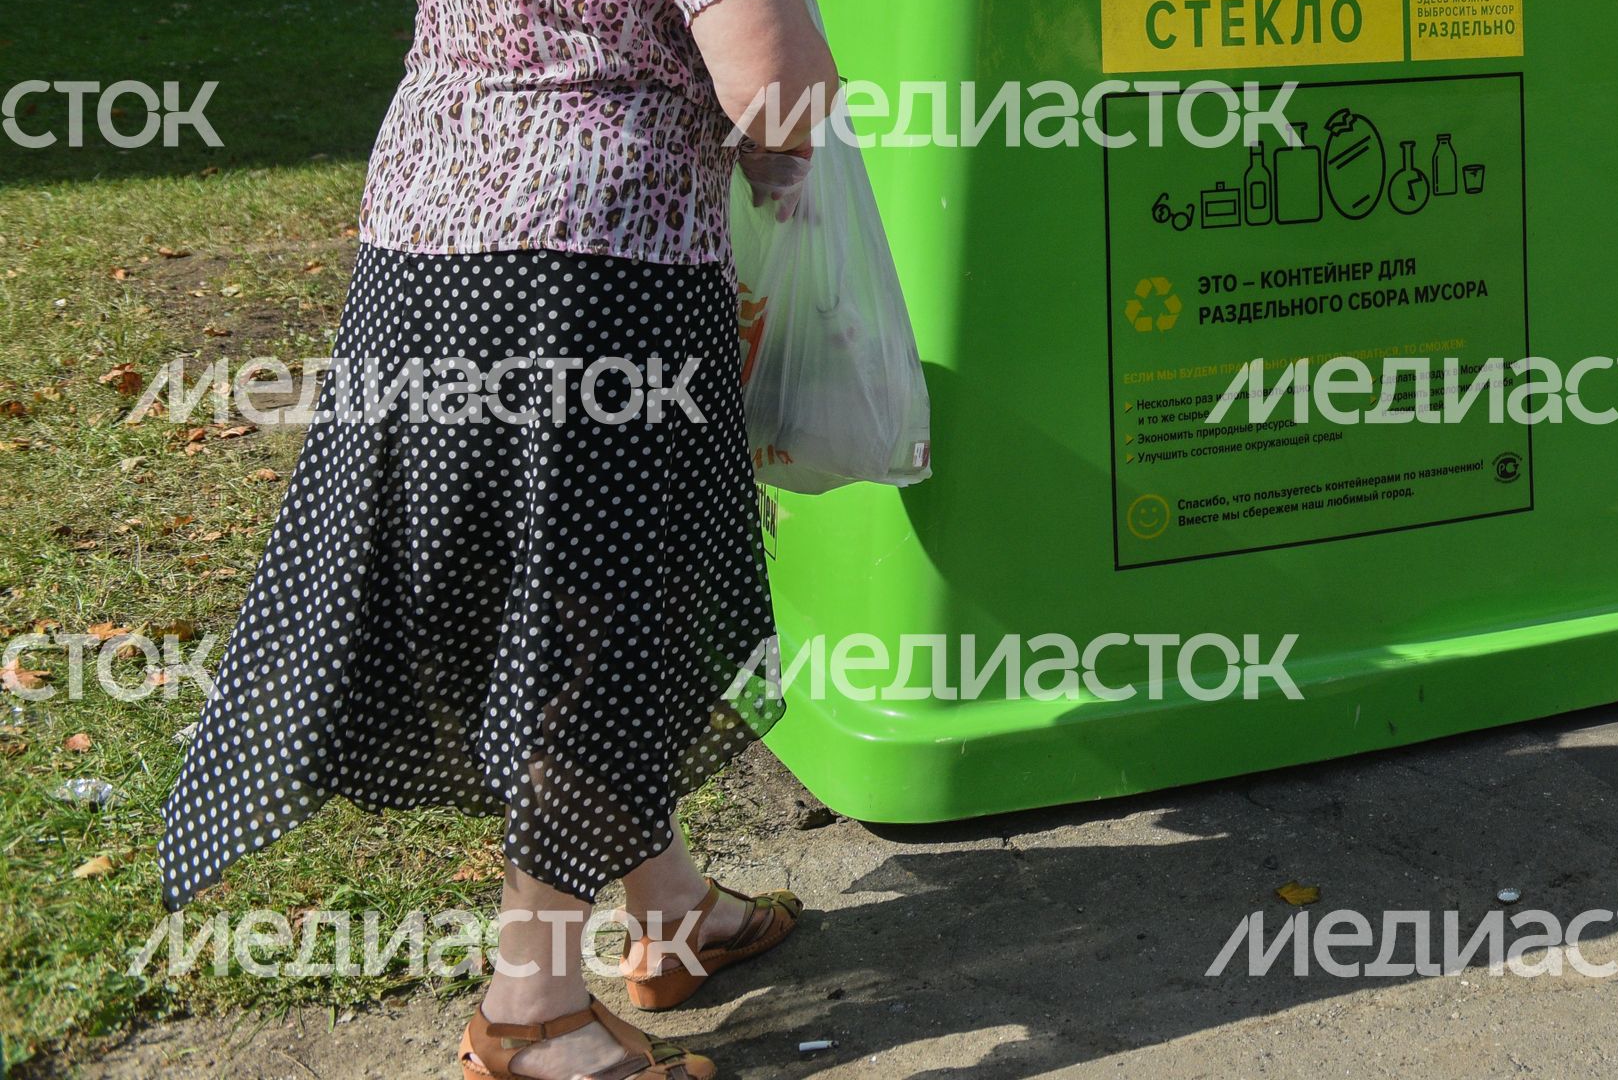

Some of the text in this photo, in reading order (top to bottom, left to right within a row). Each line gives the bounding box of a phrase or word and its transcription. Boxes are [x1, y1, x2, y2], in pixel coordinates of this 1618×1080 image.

[1417, 5, 1514, 18] ВЫБРОСИТЬ МУСОР
[1418, 19, 1515, 40] РАЗДЕЛЬНО
[1197, 273, 1238, 295] ЭТО
[1260, 262, 1373, 290] КОНТЕЙНЕР
[1378, 257, 1416, 281] ДЛЯ
[1199, 279, 1488, 325] РАЗДЕЛЬНОГО СБОРА МУСОРА
[1136, 396, 1193, 411] Несколько
[1195, 394, 1213, 406] раз
[1137, 418, 1298, 444] Экономить природные ресурсы
[1138, 416, 1144, 425] и
[1148, 415, 1159, 424] то
[1161, 413, 1175, 422] же
[1137, 431, 1343, 464] Улучшить состояние окружающей среды
[1177, 495, 1230, 511] Спасибо,
[1232, 493, 1251, 504] что
[1253, 484, 1322, 500] пользуетесь
[1325, 473, 1401, 492] контейнерами
[1403, 471, 1416, 481] по
[1418, 459, 1484, 478] назначению!
[1178, 486, 1415, 527] Вместе мы сбережем наш любимый город.
